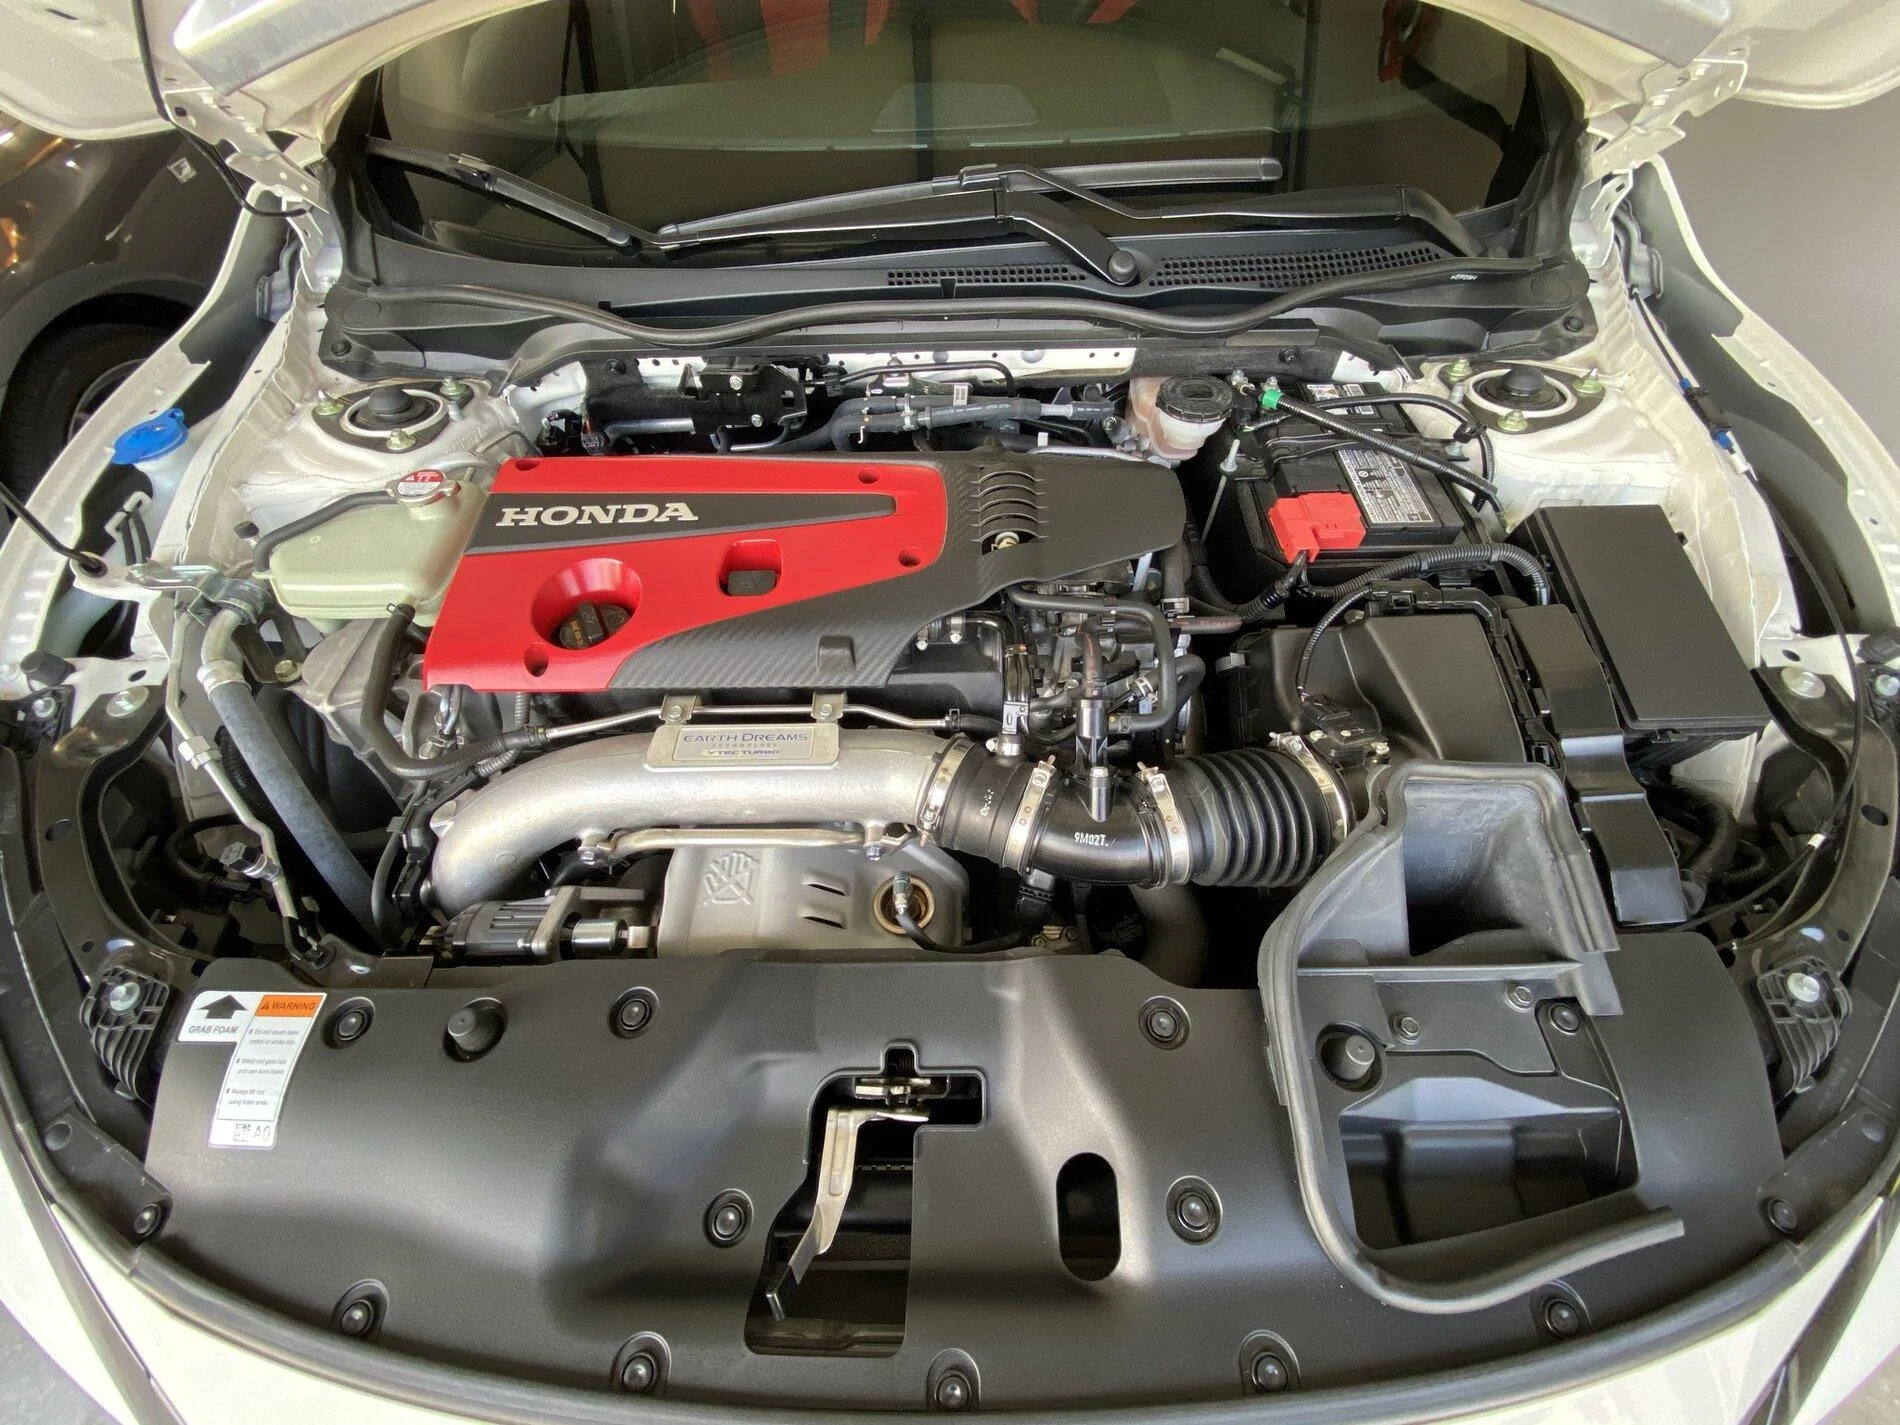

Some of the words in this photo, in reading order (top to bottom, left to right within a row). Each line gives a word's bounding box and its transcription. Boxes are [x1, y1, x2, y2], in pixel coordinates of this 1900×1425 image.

[495, 502, 699, 527] HONDA
[683, 734, 738, 743] EARTH
[741, 733, 808, 742] DREAMS
[271, 1001, 316, 1010] WARNING
[188, 1025, 212, 1034] GRAB
[213, 1025, 239, 1034] FOAM
